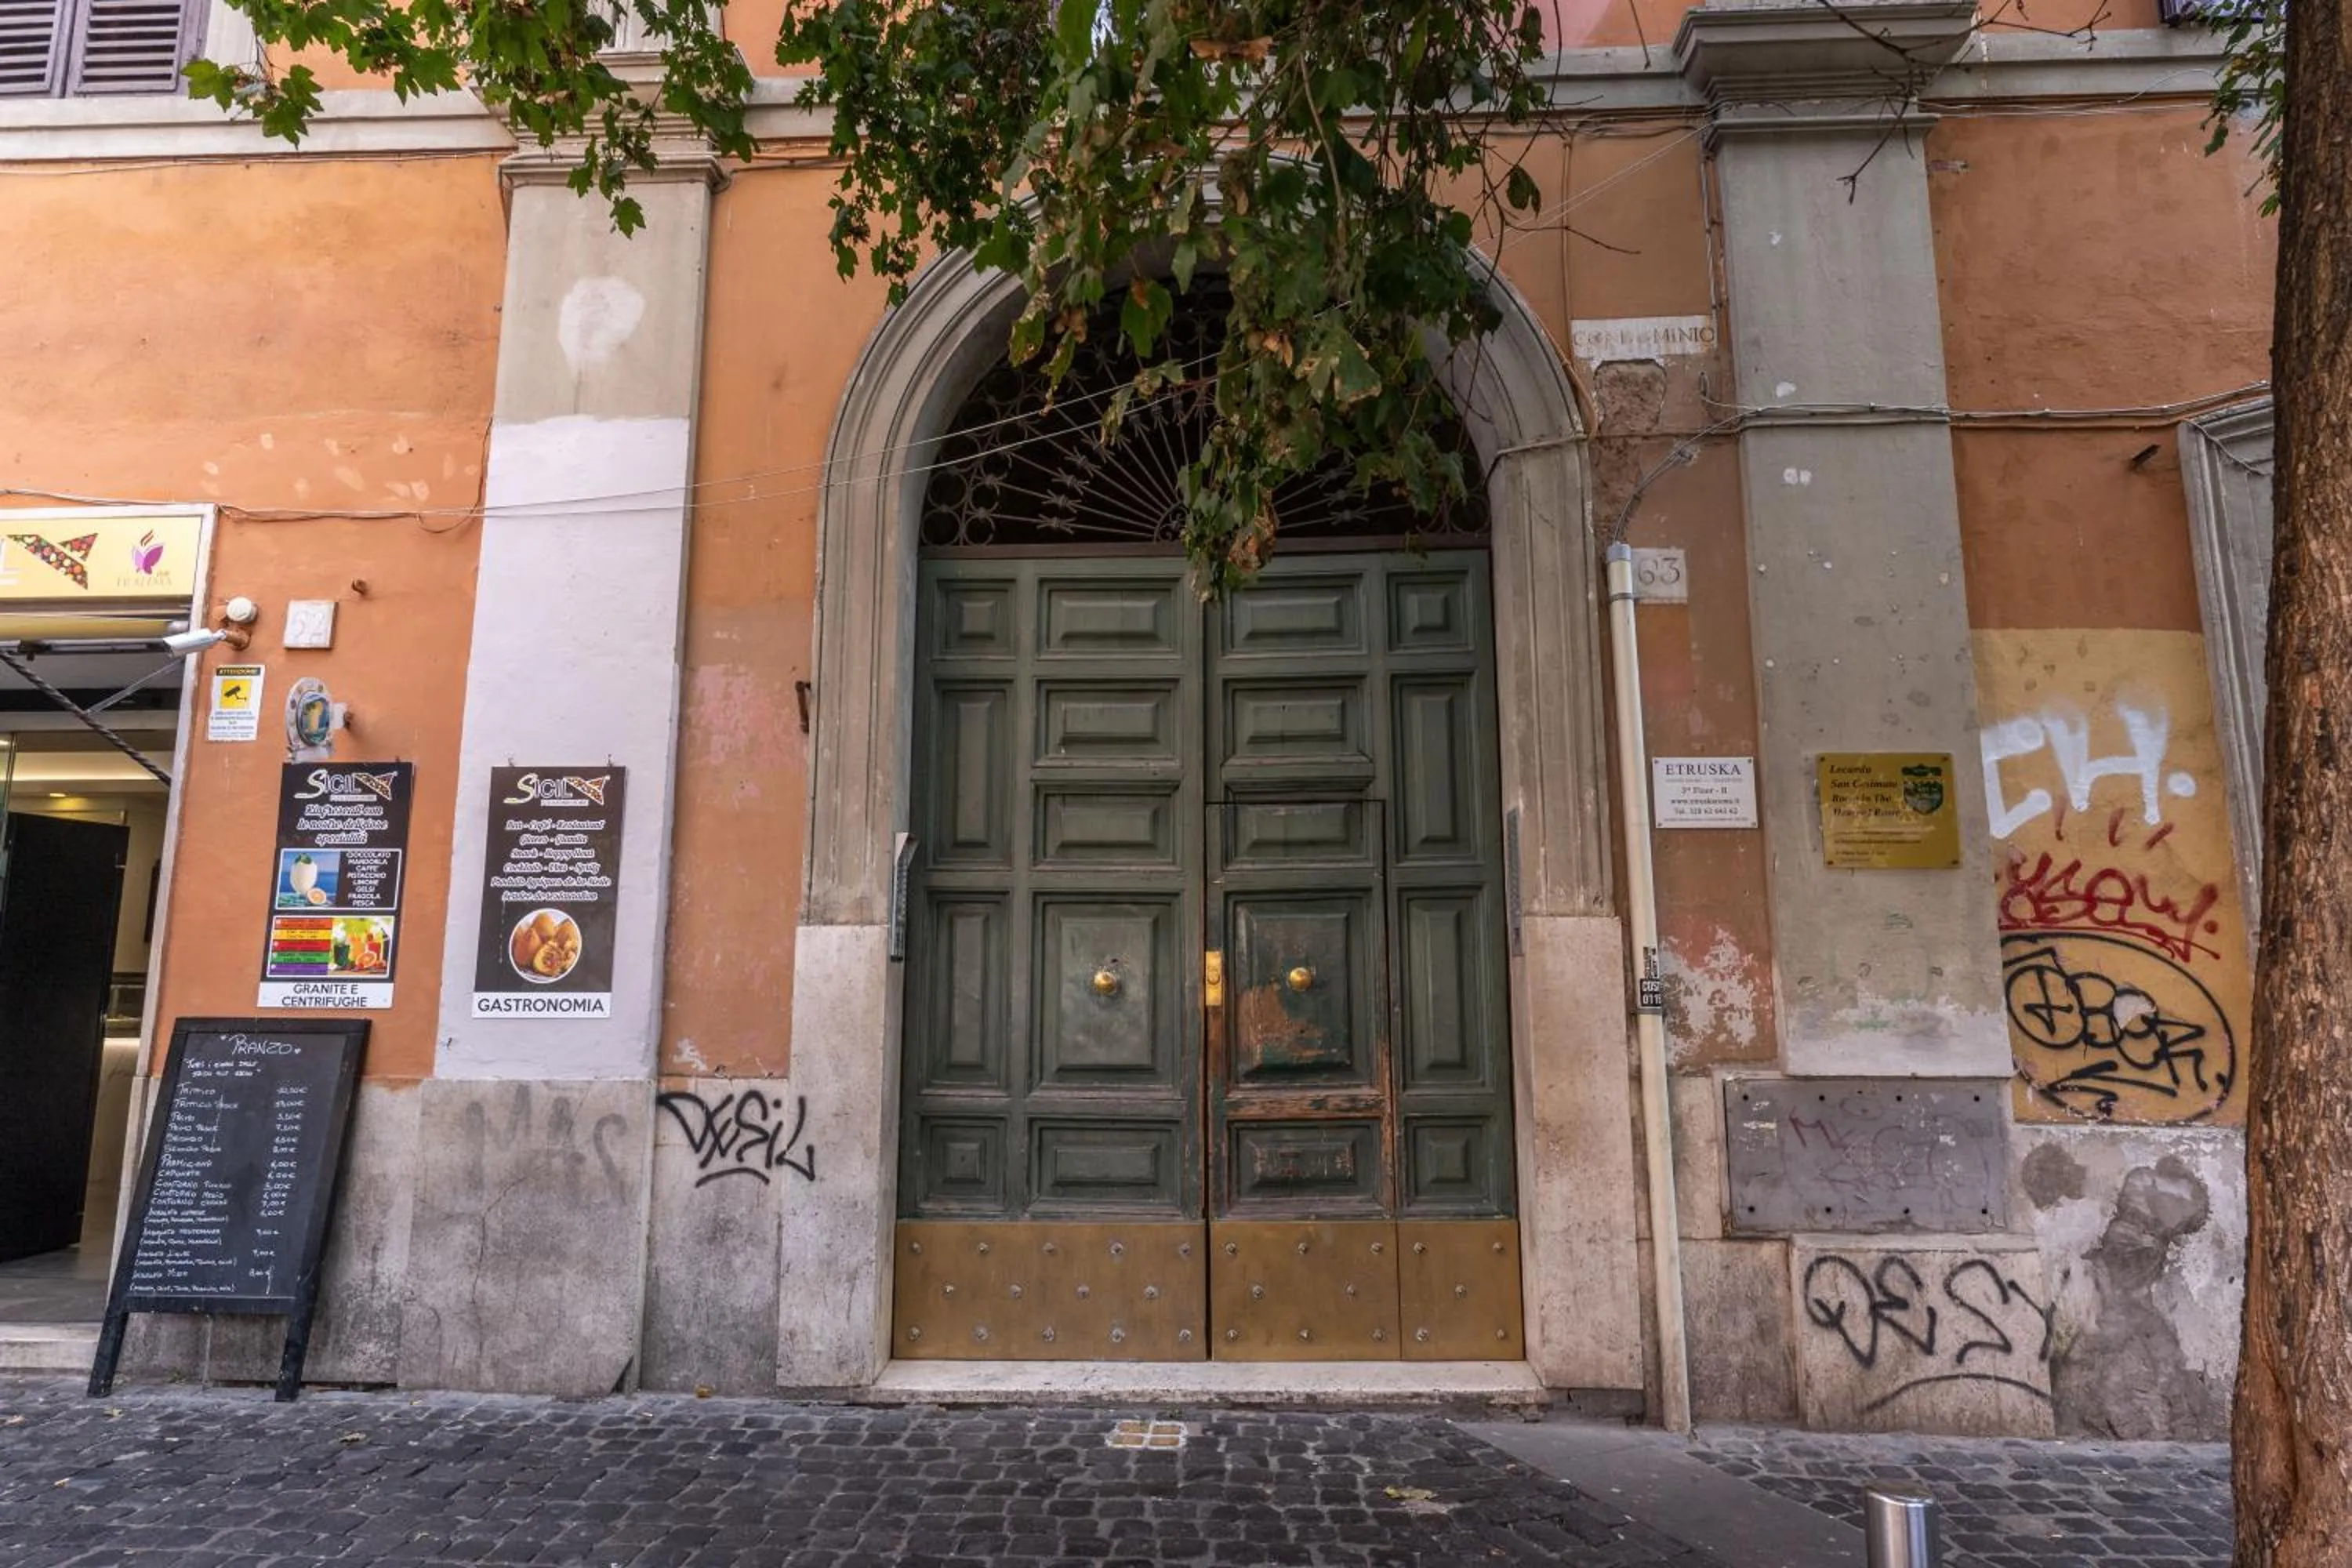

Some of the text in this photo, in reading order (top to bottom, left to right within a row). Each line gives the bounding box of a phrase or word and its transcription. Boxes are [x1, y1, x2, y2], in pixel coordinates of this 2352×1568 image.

[1638, 557, 1680, 586] 63
[1665, 764, 1741, 775] ETRUSKA
[293, 984, 358, 994] GRANITE E
[281, 996, 368, 1007] CENTRIFUGHE
[477, 998, 604, 1012] GASTRONOMIA
[229, 1033, 292, 1056] PRANZO
